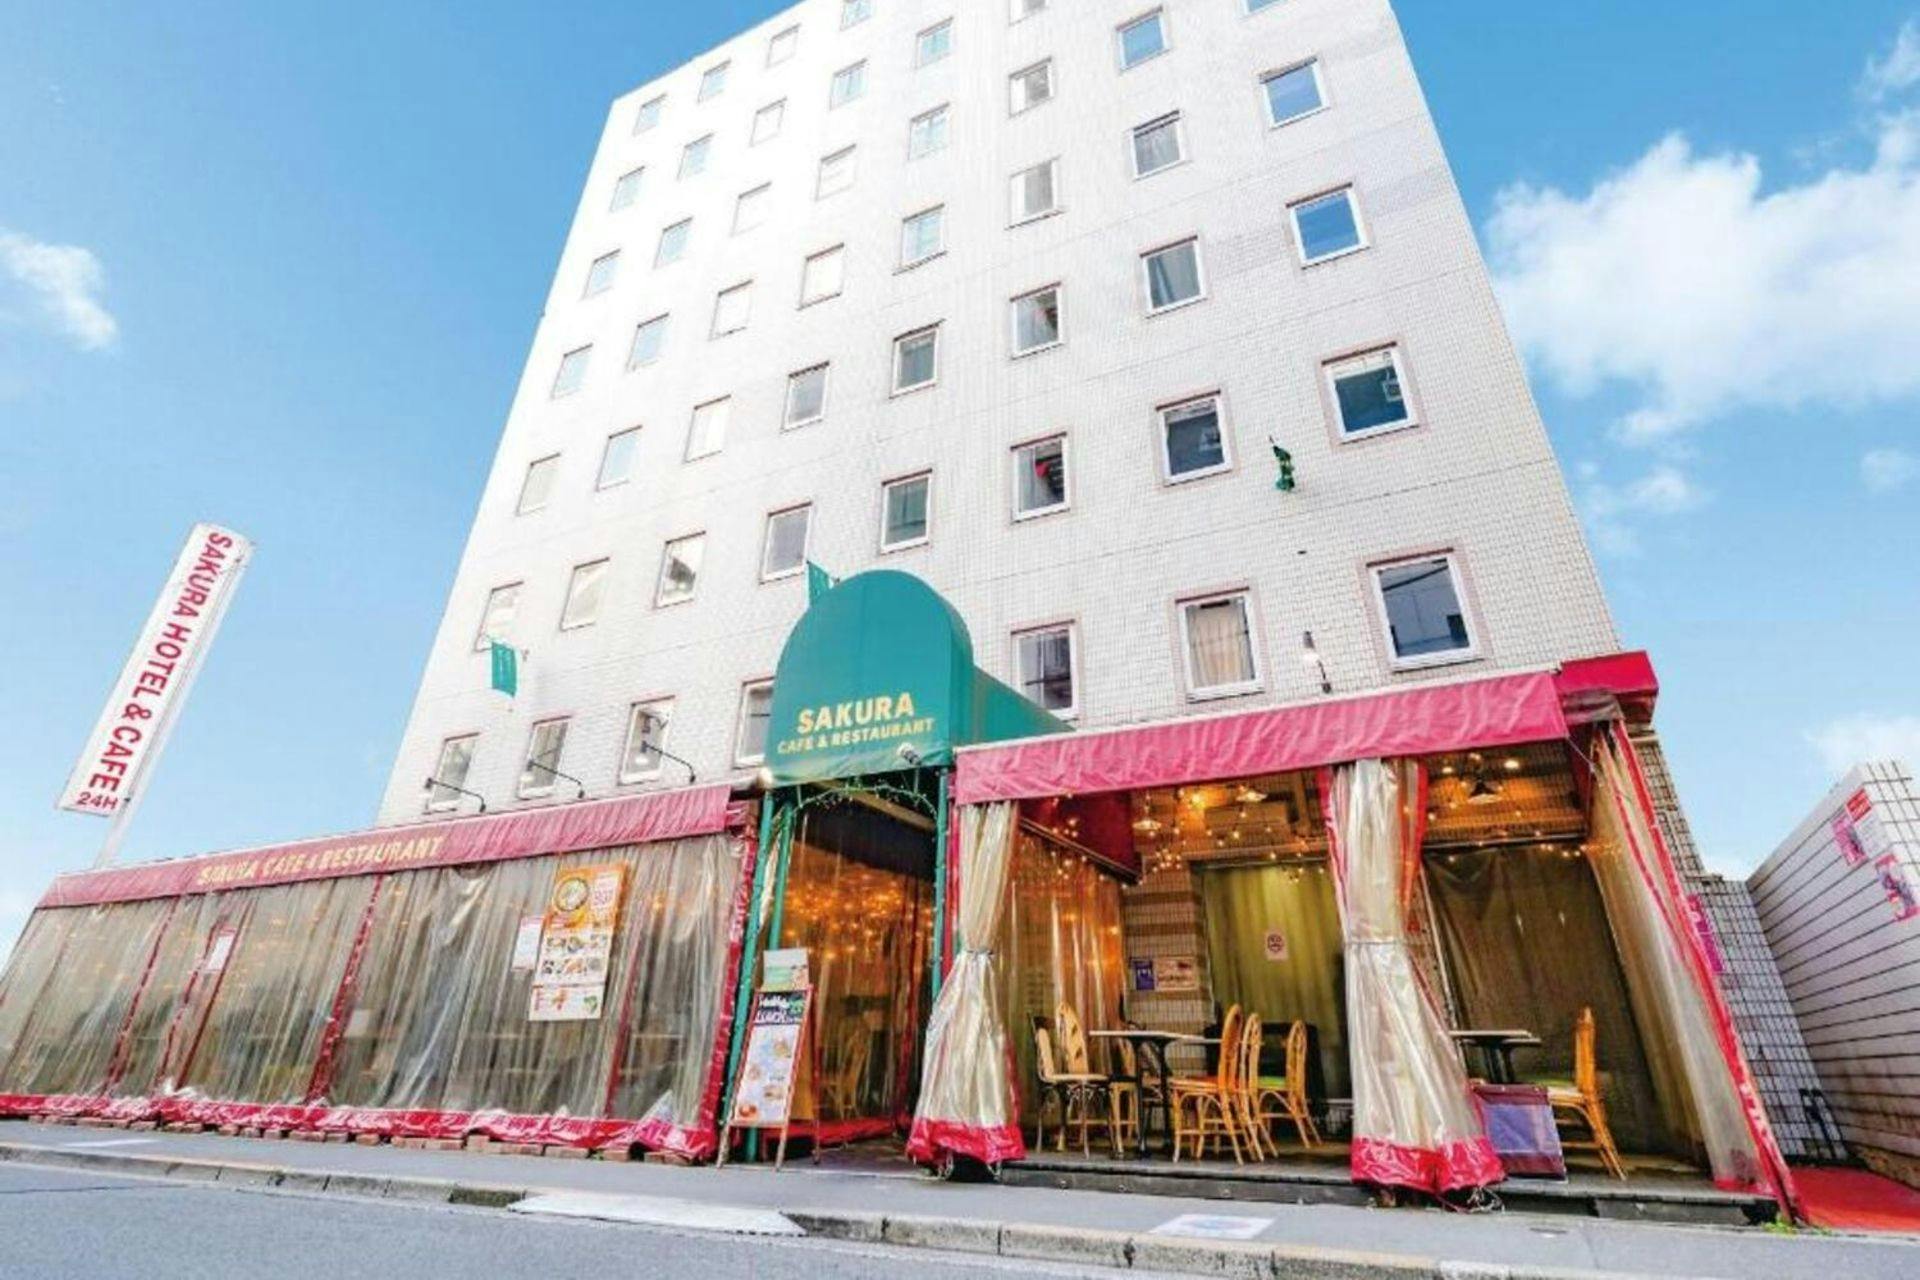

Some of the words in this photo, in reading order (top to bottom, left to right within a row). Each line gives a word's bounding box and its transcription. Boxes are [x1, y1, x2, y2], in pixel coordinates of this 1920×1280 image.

[172, 532, 232, 617] SAKURA
[133, 622, 192, 698] HOTEL
[121, 703, 152, 720] &
[797, 692, 915, 734] SAKURA
[778, 736, 813, 754] CAFE
[817, 734, 828, 748] &
[831, 718, 934, 746] RESTAURANT
[89, 725, 142, 792] CAFE
[77, 791, 118, 810] 24H
[263, 854, 301, 877] CAFE
[318, 838, 443, 869] RESTAURANT
